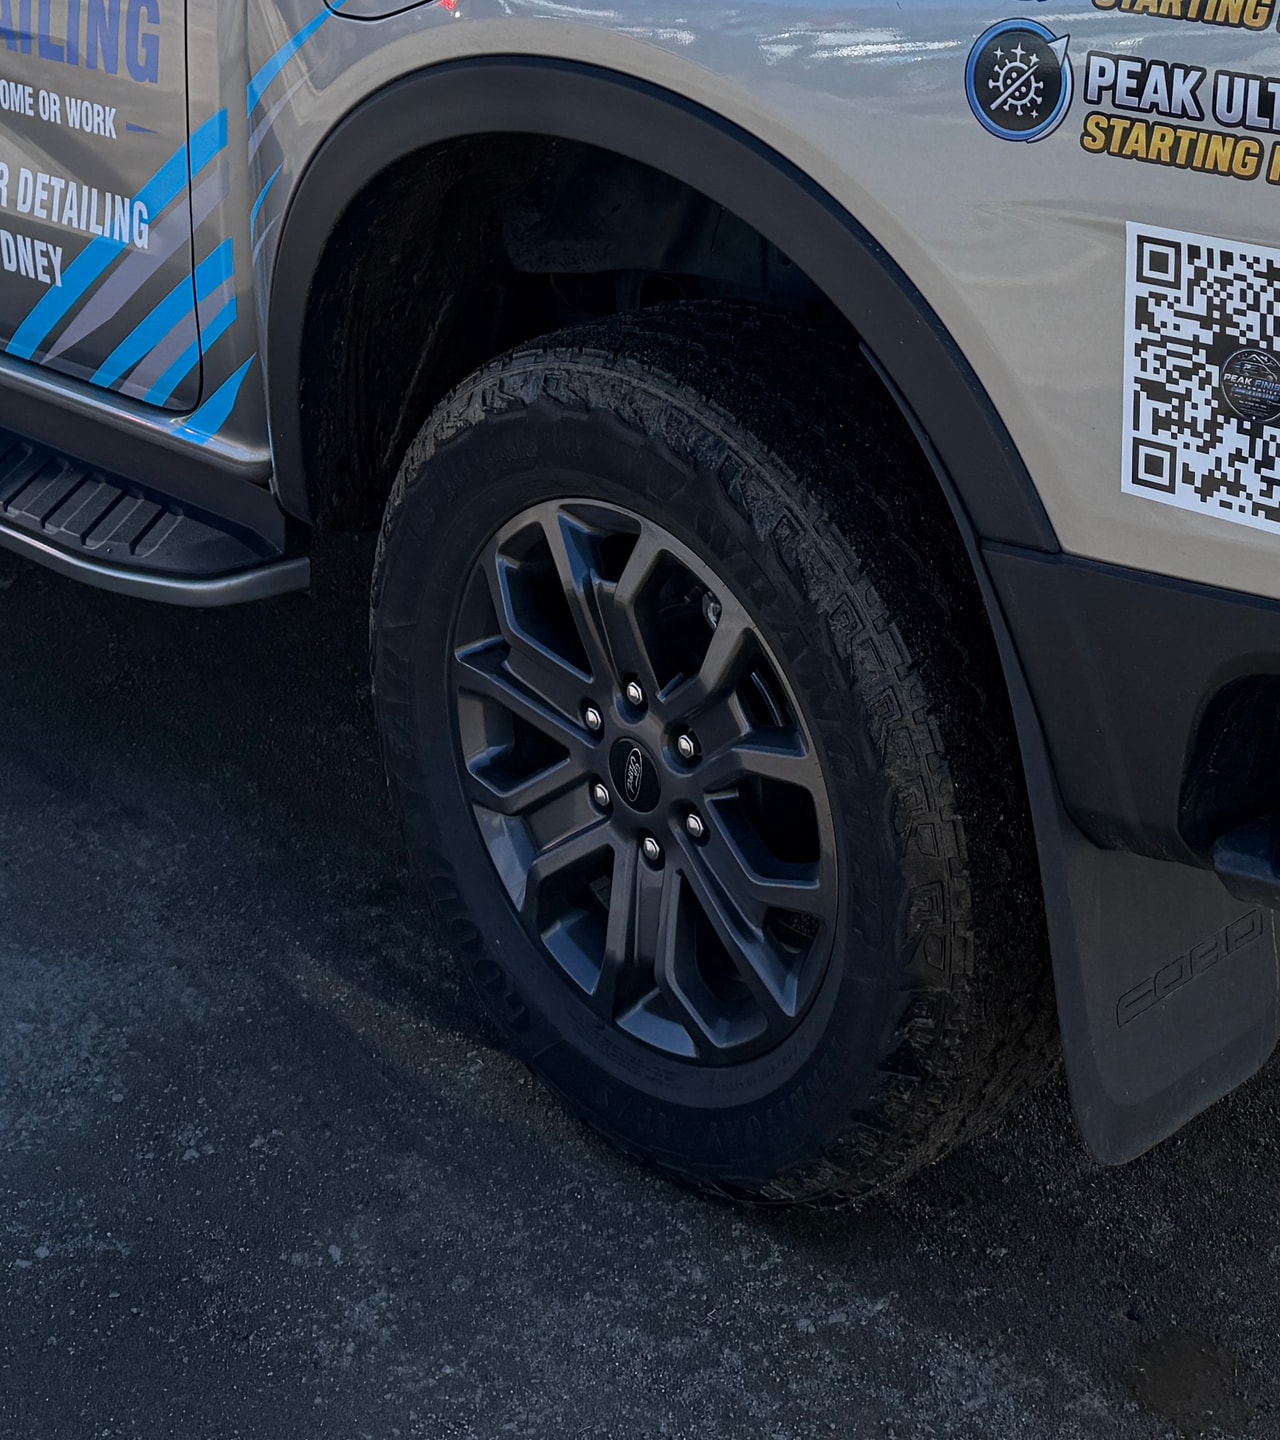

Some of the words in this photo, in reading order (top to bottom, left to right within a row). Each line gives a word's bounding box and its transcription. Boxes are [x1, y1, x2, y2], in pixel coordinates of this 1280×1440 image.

[39, 90, 61, 125] OR
[65, 96, 117, 139] WORK
[1085, 55, 1206, 119] PEAK
[1082, 115, 1261, 179] STARTING
[18, 167, 150, 250] DETAILING
[1223, 373, 1253, 385] PEAK
